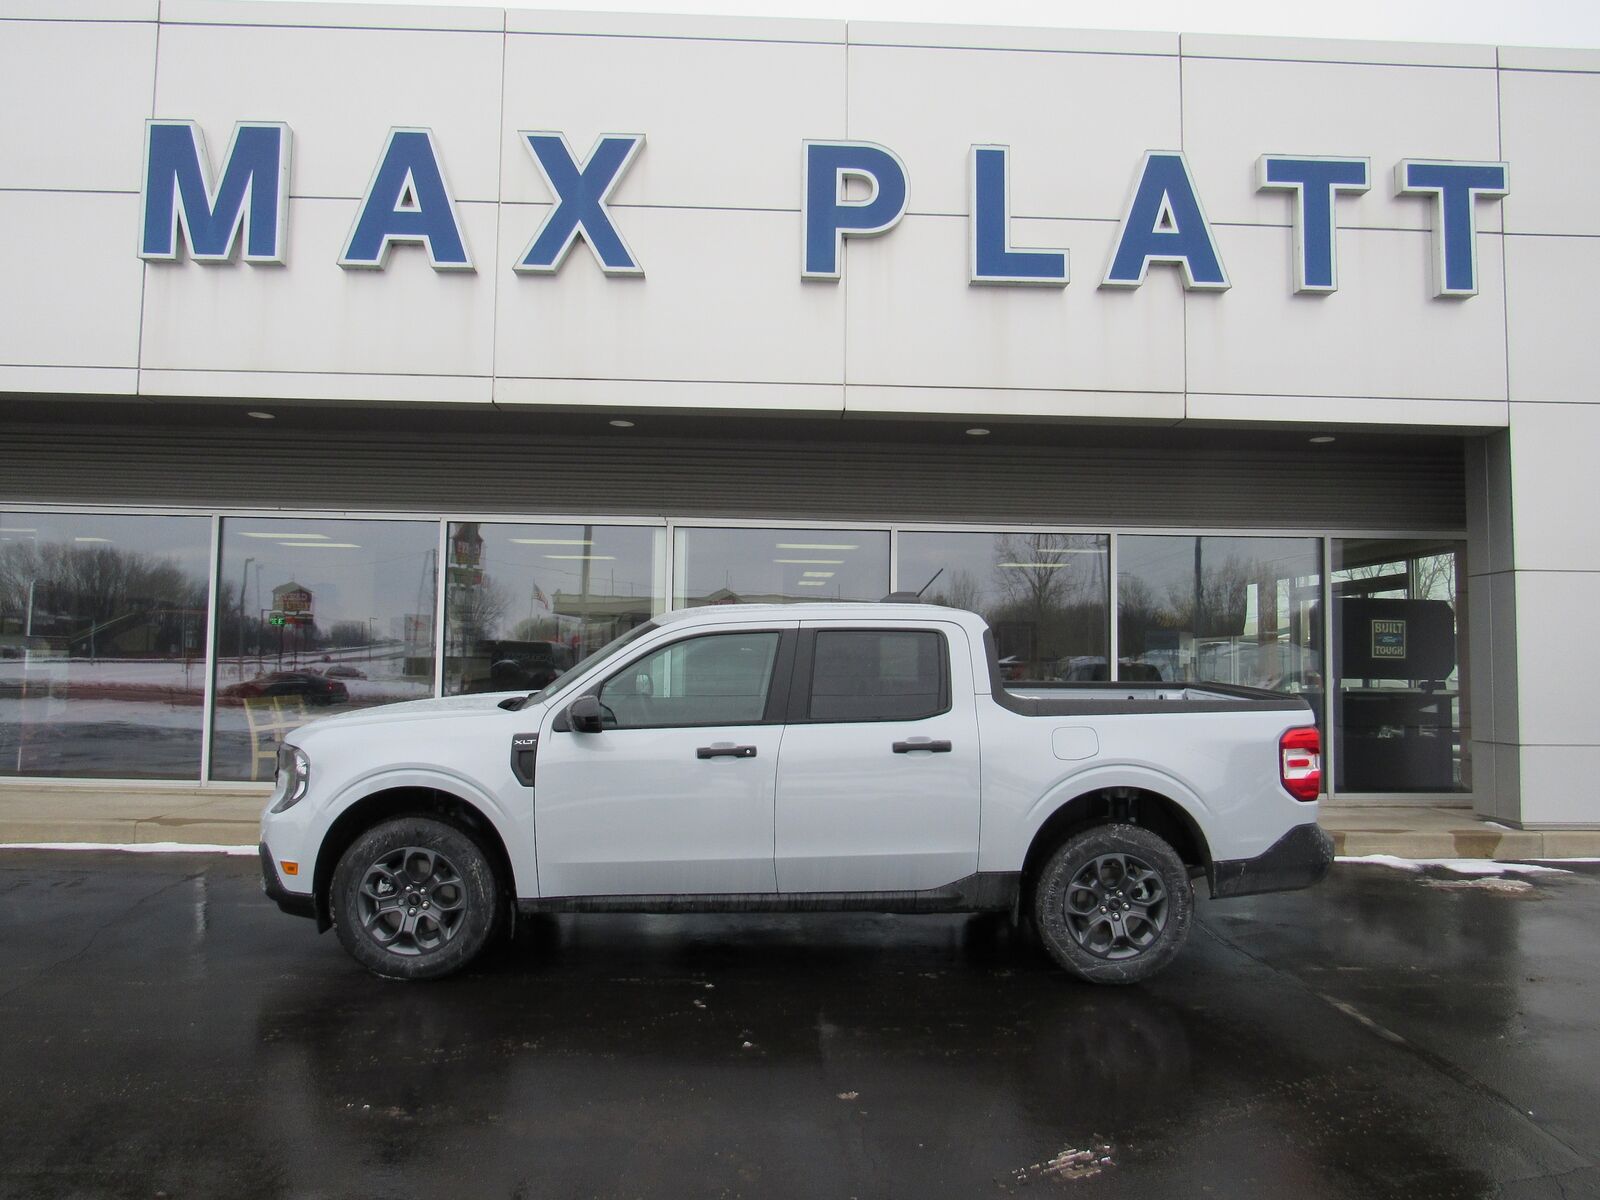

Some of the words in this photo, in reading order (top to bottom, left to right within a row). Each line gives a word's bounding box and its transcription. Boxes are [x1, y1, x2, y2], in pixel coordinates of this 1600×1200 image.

[137, 118, 647, 278] MAX
[801, 139, 1510, 300] PLATT
[1375, 623, 1403, 633] BUILT
[1376, 646, 1403, 655] TOUGH
